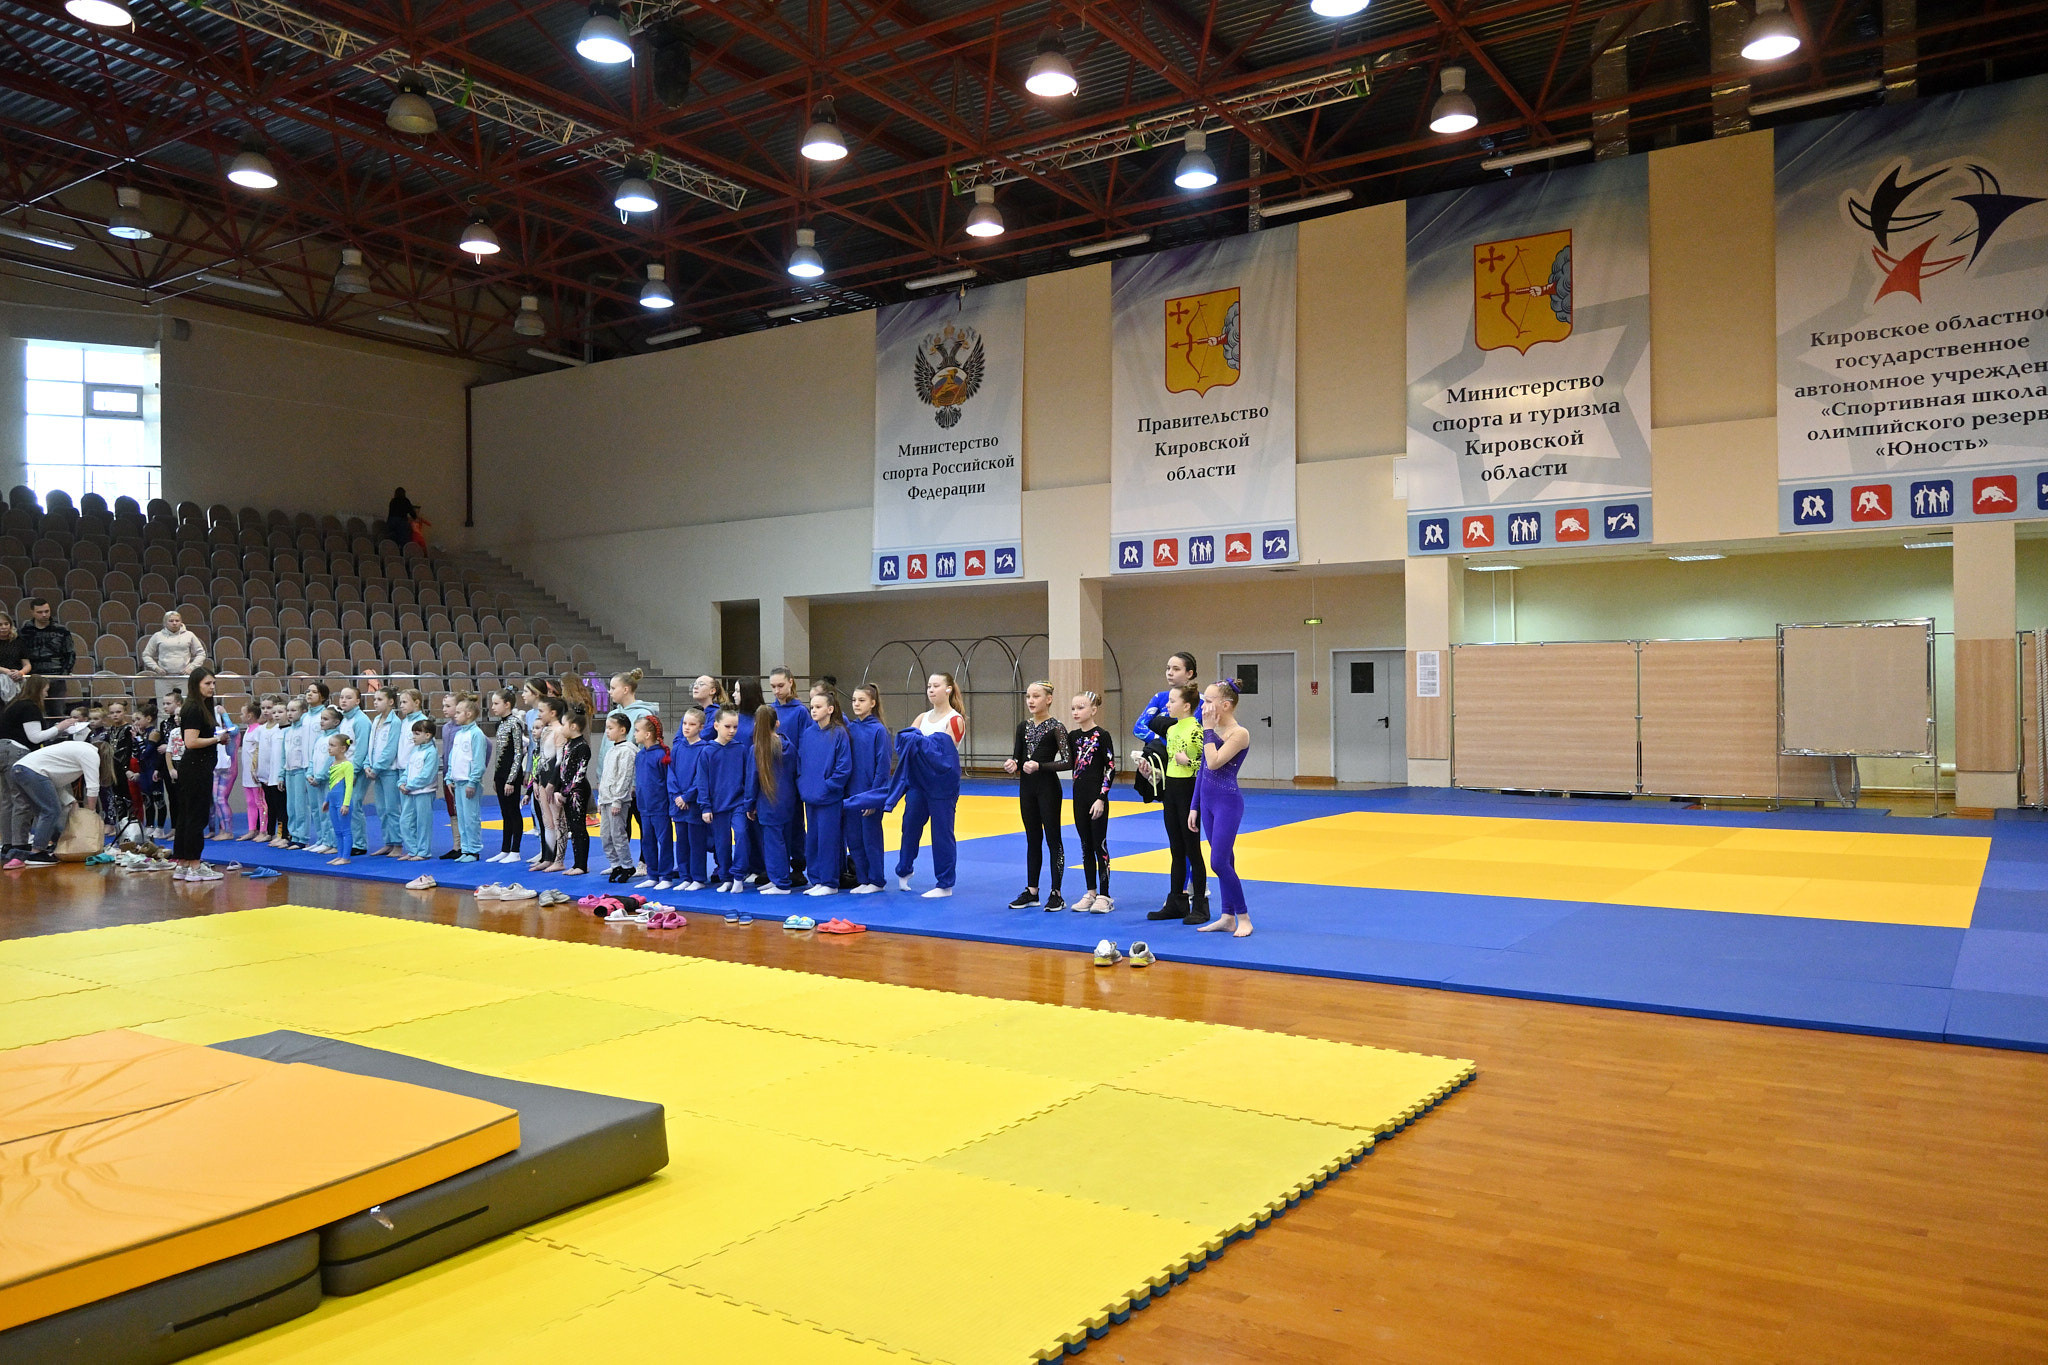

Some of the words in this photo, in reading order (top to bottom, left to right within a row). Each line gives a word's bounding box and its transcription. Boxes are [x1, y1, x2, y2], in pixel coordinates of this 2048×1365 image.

[1810, 322, 1930, 348] Кировское
[1935, 307, 2048, 332] областно
[1835, 336, 2030, 369] государственное
[1446, 374, 1605, 405] Министерство
[1794, 374, 1926, 398] автономное
[1930, 360, 2048, 388] учрежден
[1821, 393, 1966, 417] «Спортивная
[1971, 385, 2048, 404] школа
[1136, 406, 1269, 435] Правительство
[1432, 414, 1504, 433] спорта
[1508, 412, 1523, 425] и
[1527, 401, 1621, 426] туризма
[1807, 416, 1966, 441] олимпийского
[1971, 408, 2048, 431] резерв
[898, 436, 999, 458] Министерство
[1154, 432, 1250, 459] Кировской
[1464, 429, 1585, 458] Кировской
[1875, 438, 1989, 457] «Юность»
[882, 466, 929, 482] спорта
[931, 454, 1015, 477] Российской
[1166, 464, 1237, 482] области
[1480, 462, 1568, 482] области
[907, 482, 986, 501] Федерации
